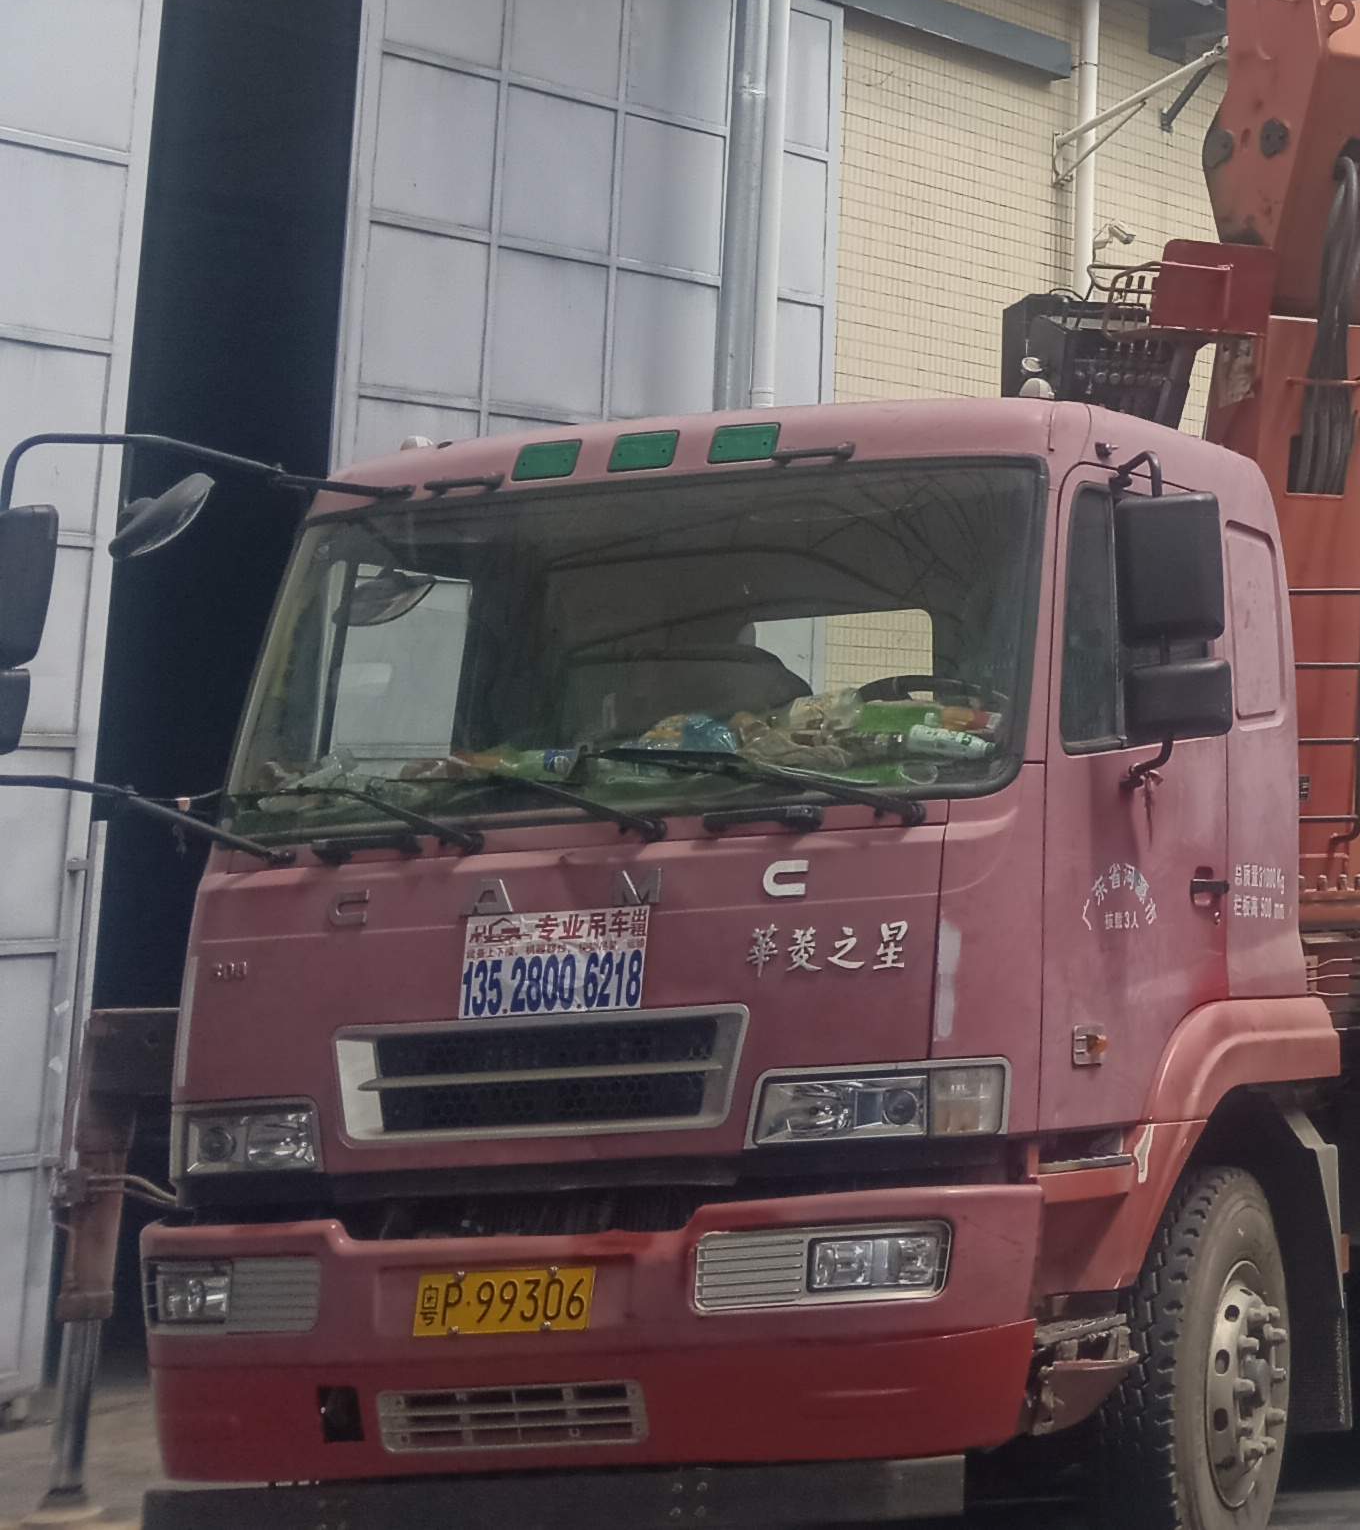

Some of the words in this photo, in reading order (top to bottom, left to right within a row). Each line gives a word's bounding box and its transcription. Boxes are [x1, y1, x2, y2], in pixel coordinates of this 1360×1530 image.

[535, 908, 648, 942] 专业吊车出租
[463, 949, 643, 1017] 135.2800.6218
